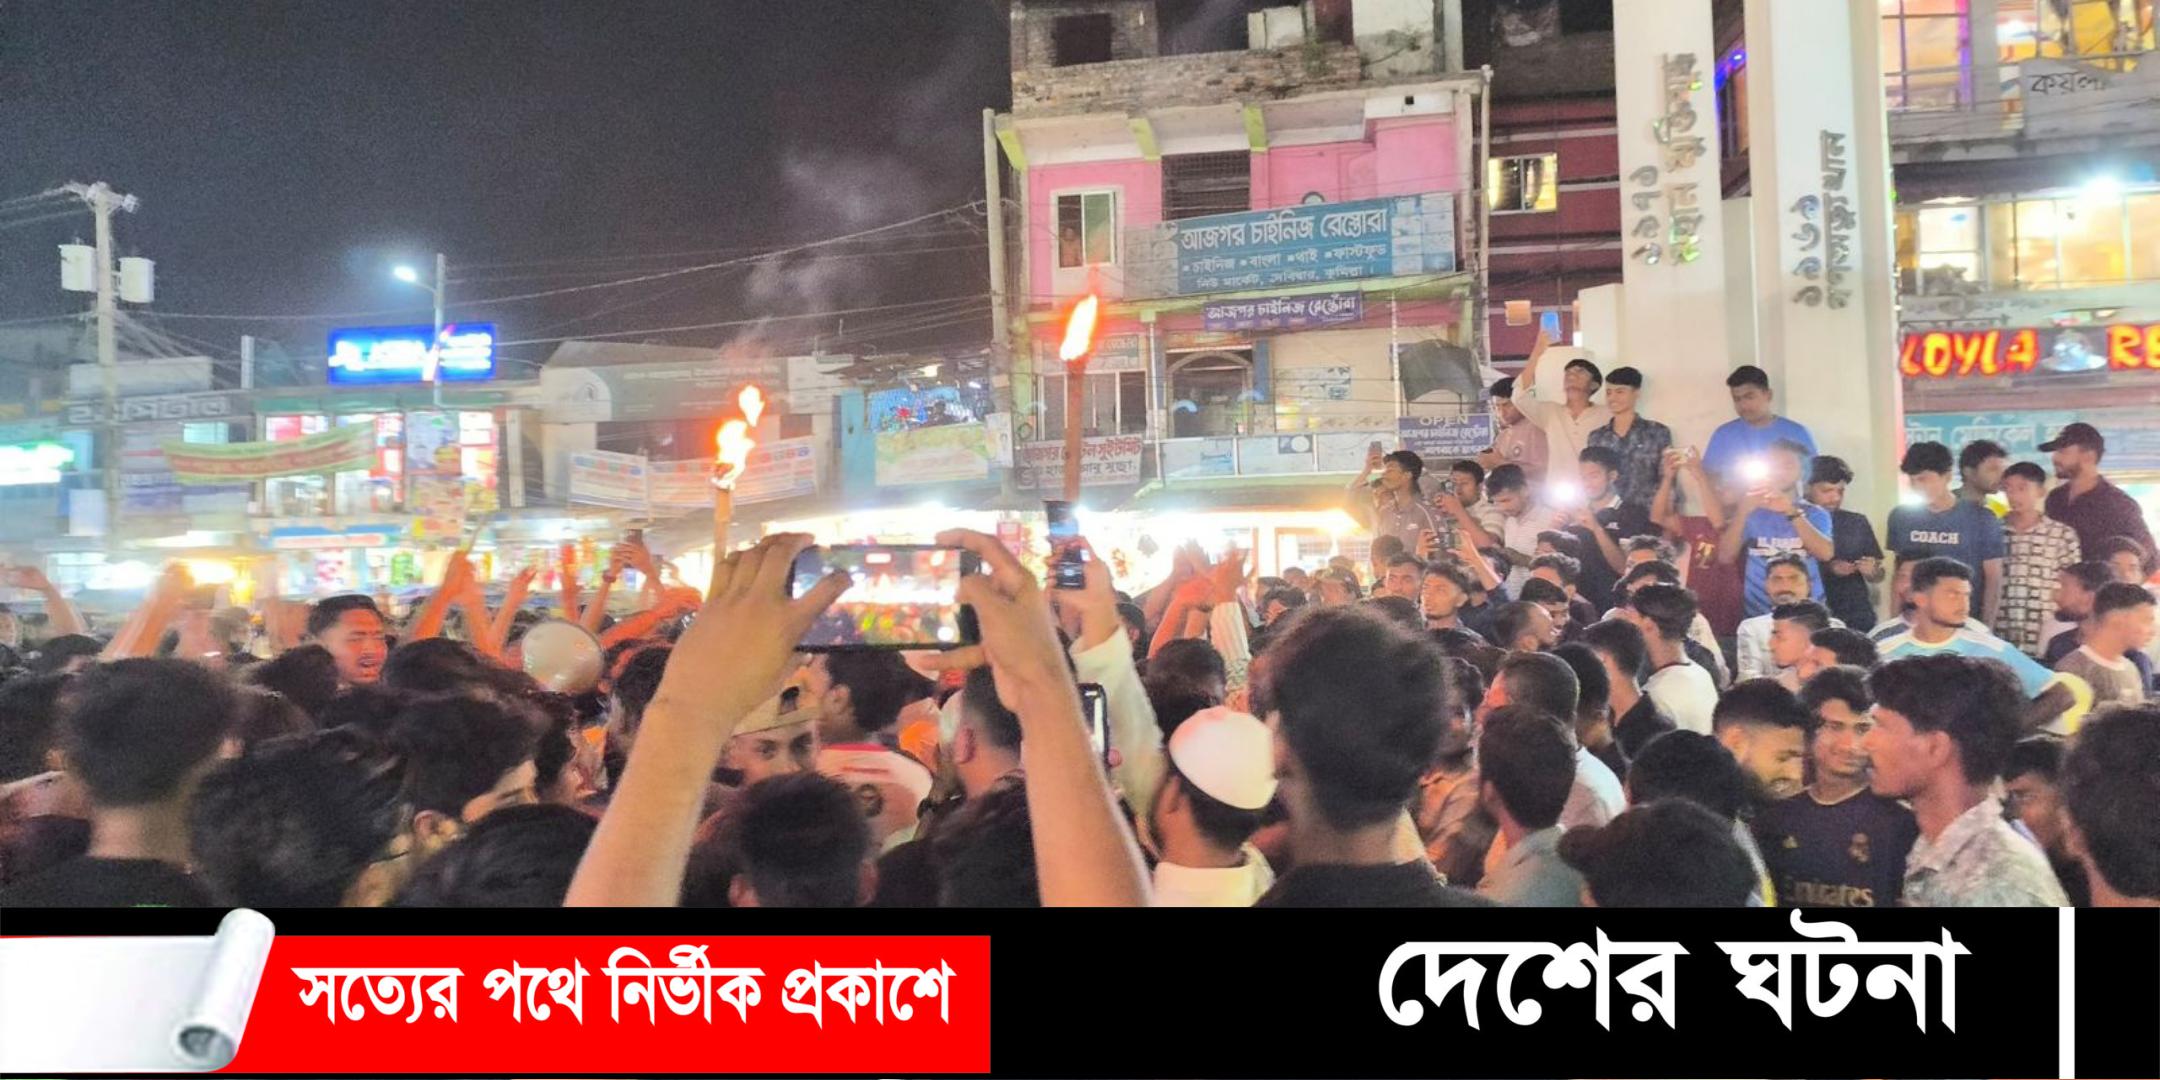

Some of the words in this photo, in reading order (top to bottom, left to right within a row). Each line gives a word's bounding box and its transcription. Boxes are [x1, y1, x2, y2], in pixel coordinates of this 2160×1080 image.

[1629, 164, 1662, 266] ১৯৭১
[1181, 223, 1246, 249] আজগর
[1250, 209, 1315, 244] চাইনিজ
[1192, 256, 1235, 272] চাইনিজ
[1249, 253, 1281, 267] বাংলা
[1294, 248, 1318, 263] থাই
[1206, 304, 1255, 320] আজগর
[1257, 296, 1305, 316] চাইনিজ
[1420, 415, 1468, 426] OPEN
[1910, 530, 1959, 545] COACH
